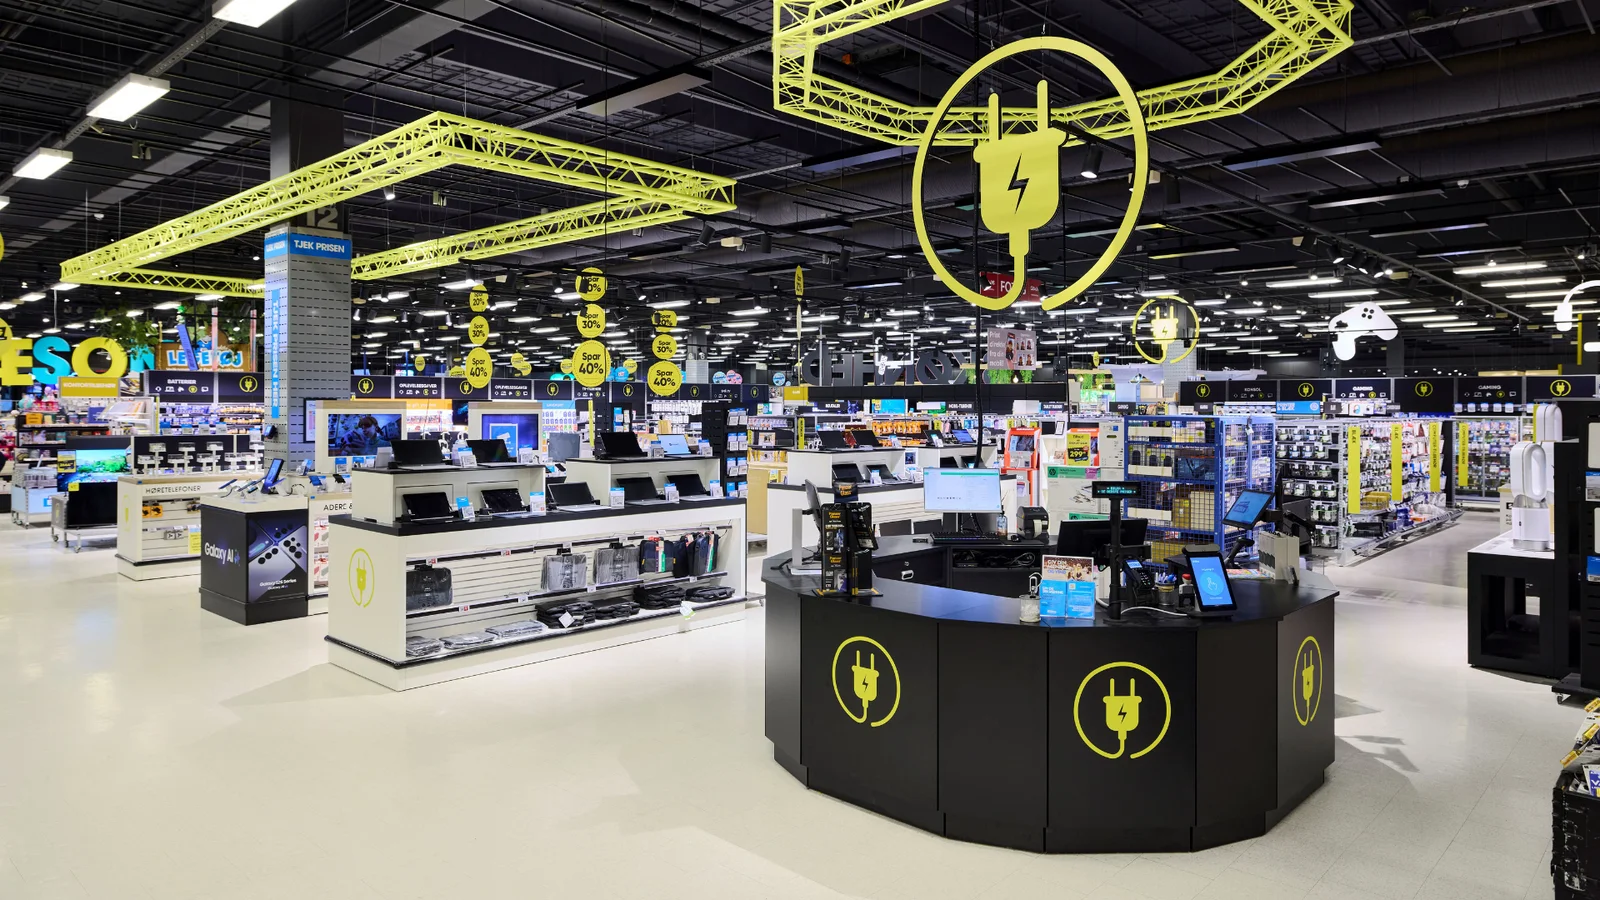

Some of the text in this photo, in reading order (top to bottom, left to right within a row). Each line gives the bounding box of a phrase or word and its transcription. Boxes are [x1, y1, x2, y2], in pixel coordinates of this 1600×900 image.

[306, 206, 338, 229] 12
[294, 239, 345, 253] TJEK PRISEN
[473, 323, 485, 331] Spar
[582, 320, 601, 329] 30%
[472, 329, 486, 338] 30%
[658, 340, 671, 348] Spar
[656, 346, 673, 354] 30%
[472, 357, 486, 368] Spar
[582, 352, 601, 363] Spar
[470, 367, 488, 378] 40%
[579, 363, 604, 375] 40%
[656, 369, 674, 379] Spar
[653, 377, 676, 388] 40%
[146, 485, 201, 494] HØRETELEFONER
[204, 541, 227, 565] Galaxy
[227, 548, 234, 563] AI
